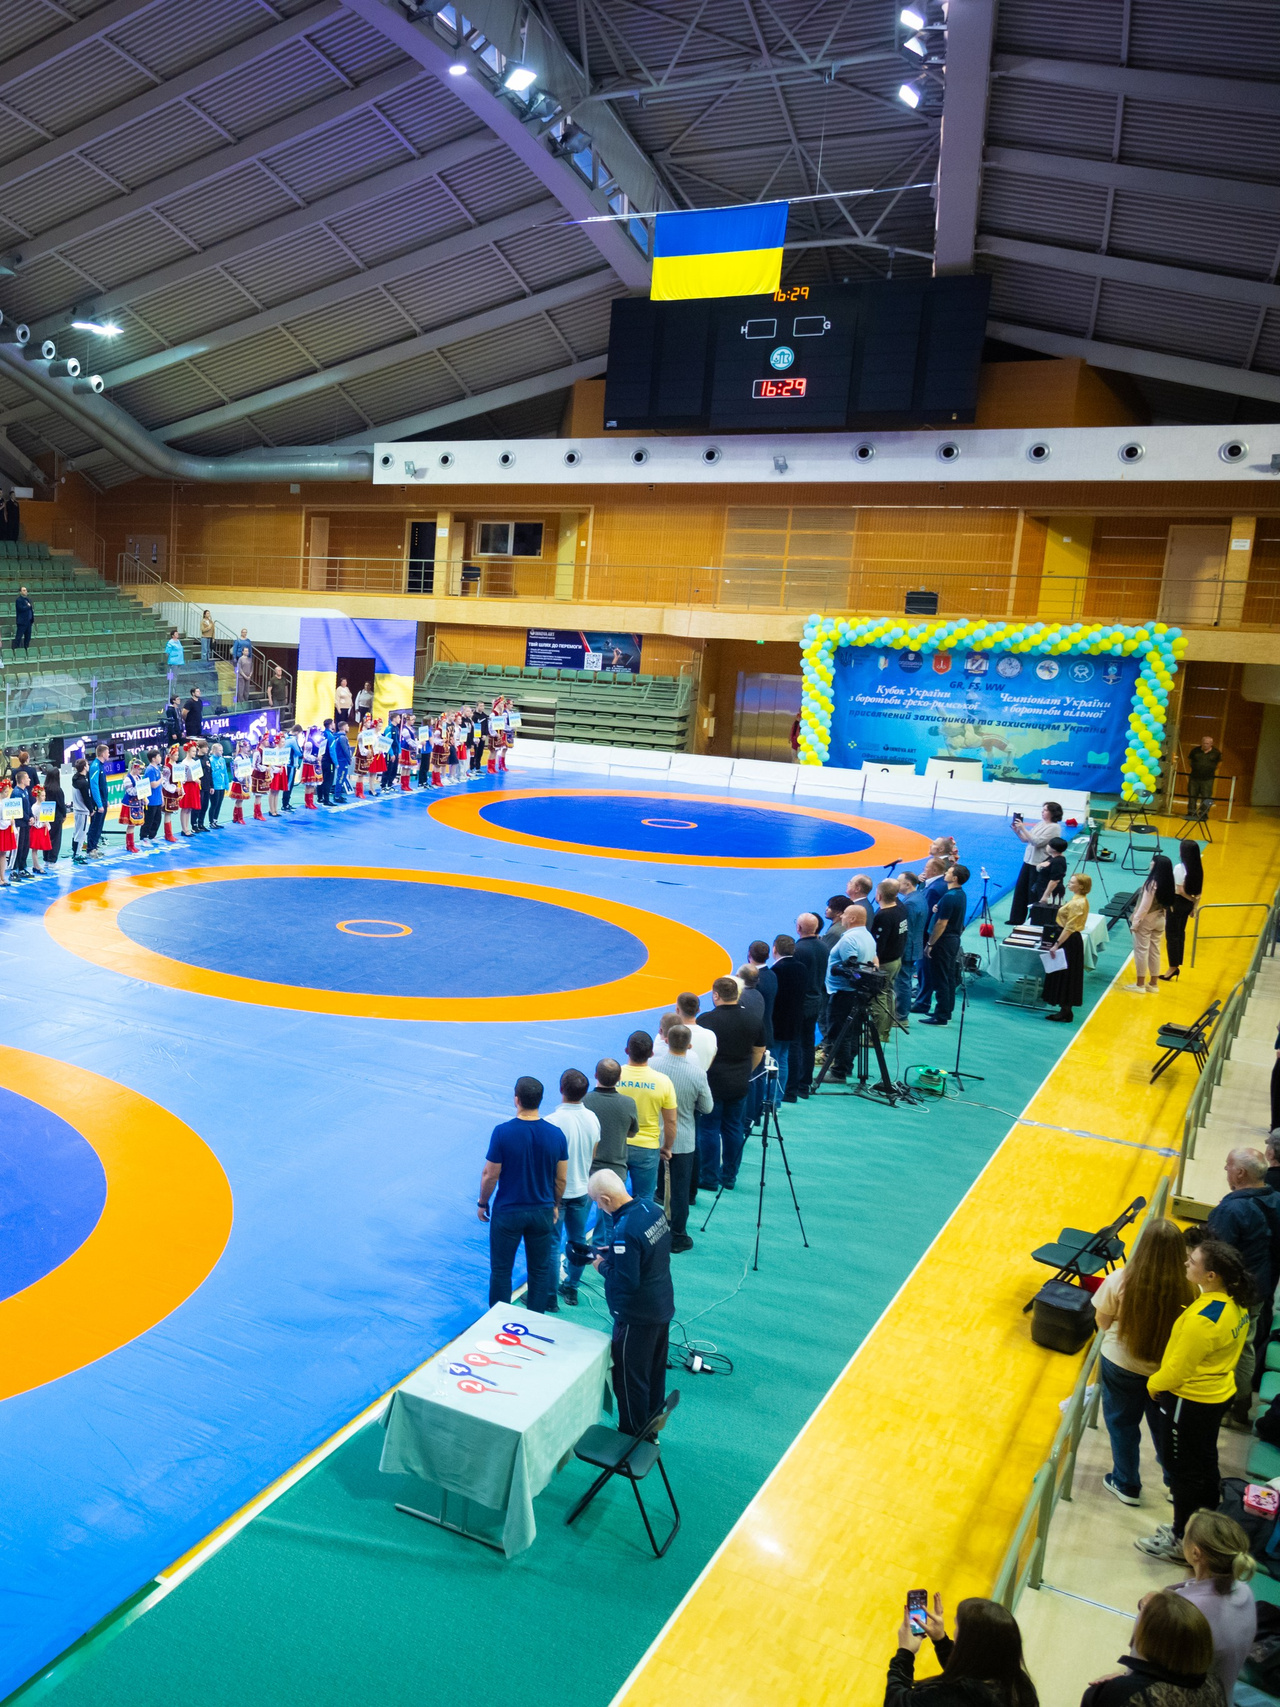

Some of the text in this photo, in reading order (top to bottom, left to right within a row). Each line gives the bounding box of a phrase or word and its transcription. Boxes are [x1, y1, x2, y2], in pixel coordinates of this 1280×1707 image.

[773, 286, 810, 302] 16:29
[740, 325, 748, 334] H
[823, 320, 831, 330] G
[761, 378, 806, 397] 16:29
[876, 684, 951, 699] Кубок України
[949, 680, 1006, 692] GR, FS, WW
[855, 693, 901, 706] боротьби
[902, 698, 980, 711] греко-римської
[1000, 692, 1111, 710] Чемпіонат України
[1010, 703, 1061, 717] боротьби
[1063, 708, 1106, 719] вільної
[848, 709, 911, 720] присвячений
[913, 714, 975, 725] захисникам
[995, 720, 1061, 731] захисницям
[1063, 723, 1107, 735] України
[947, 769, 954, 779] 1
[615, 1080, 656, 1090] UKRAINE
[505, 1323, 526, 1335] 5
[498, 1334, 518, 1344] 1
[449, 1364, 469, 1375] 4
[461, 1381, 483, 1392] 2
